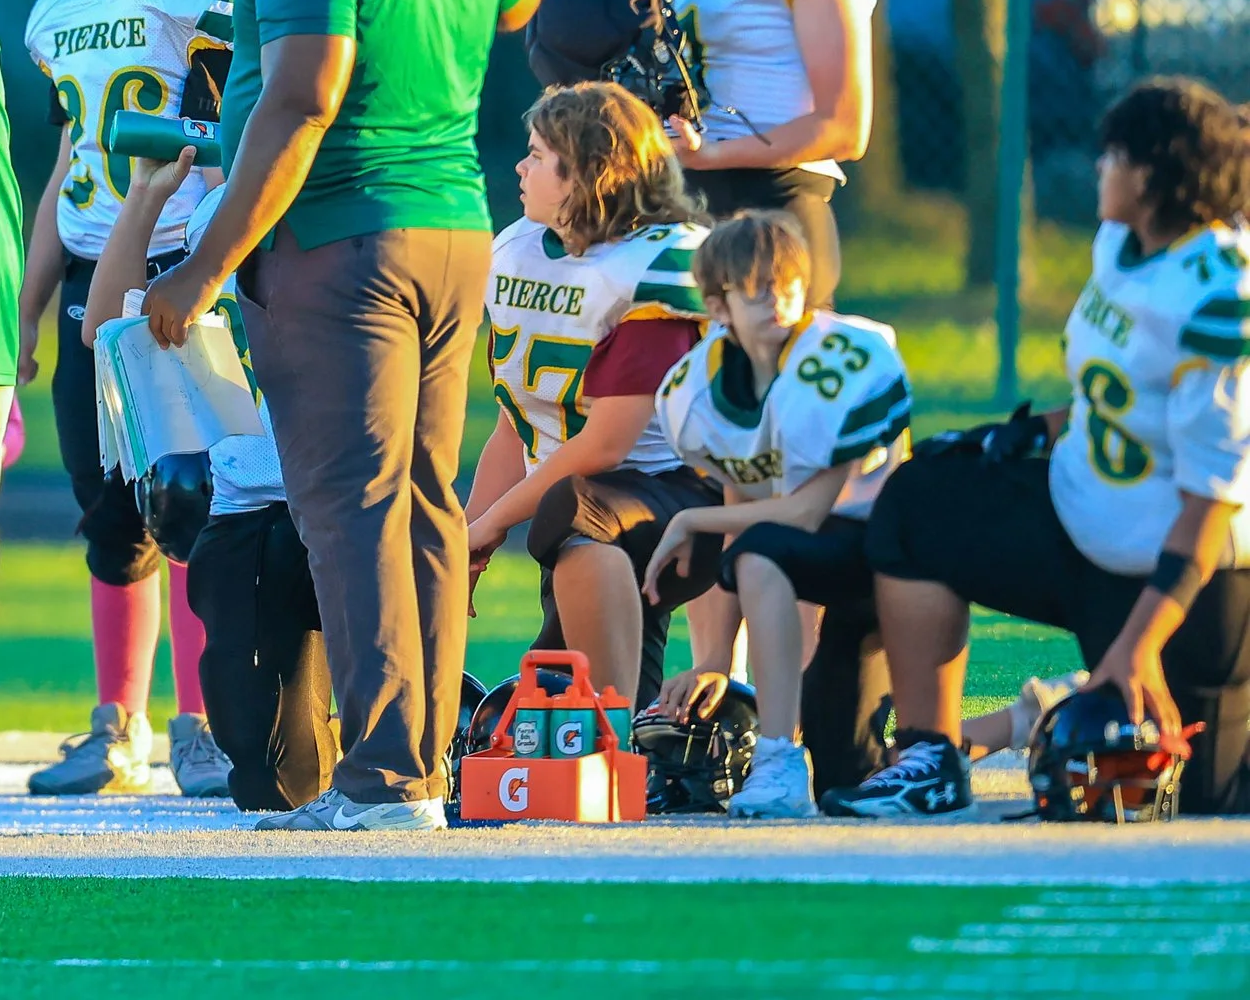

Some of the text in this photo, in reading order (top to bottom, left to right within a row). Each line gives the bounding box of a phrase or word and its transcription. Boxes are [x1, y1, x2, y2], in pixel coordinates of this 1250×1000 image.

[52, 17, 147, 60] PIERCE
[493, 275, 586, 316] PIERCE
[797, 333, 870, 401] 83
[555, 721, 583, 755] G
[499, 767, 530, 812] G
